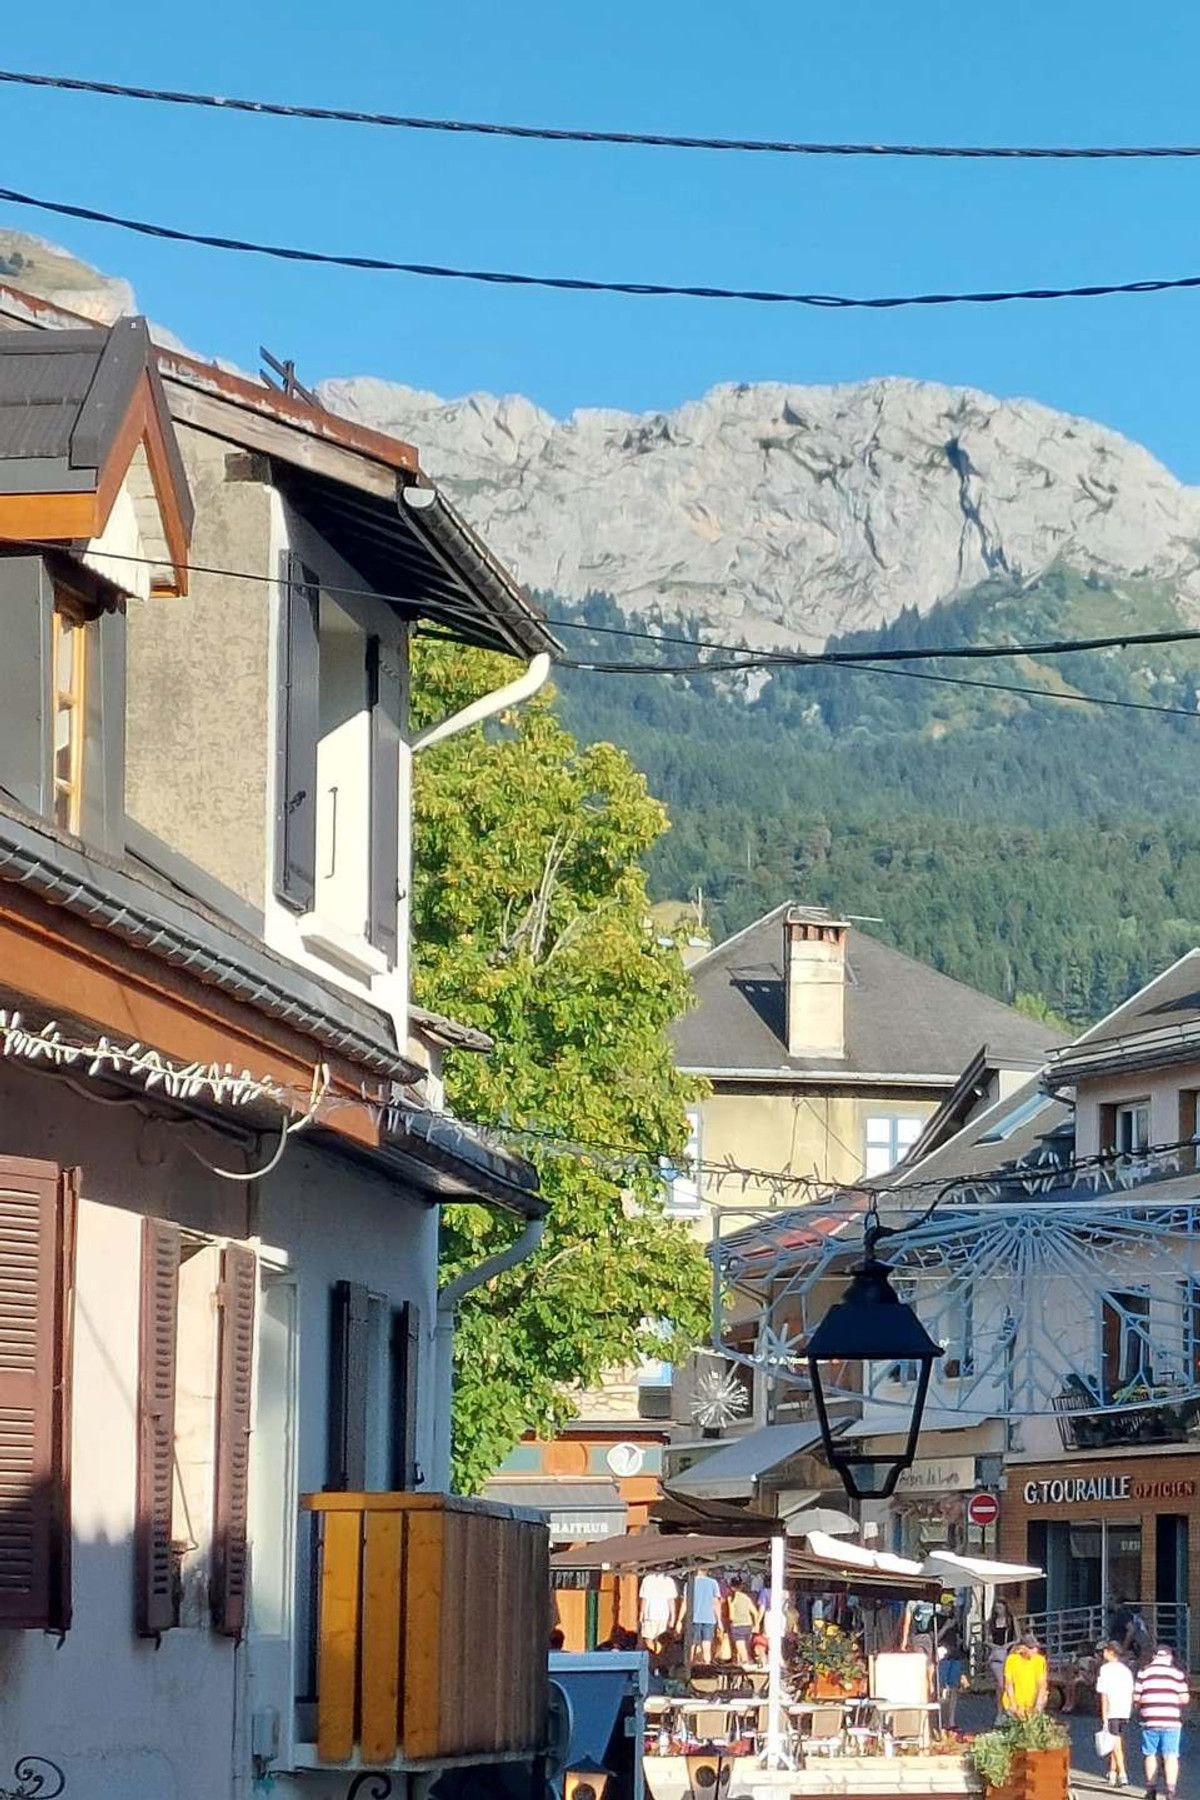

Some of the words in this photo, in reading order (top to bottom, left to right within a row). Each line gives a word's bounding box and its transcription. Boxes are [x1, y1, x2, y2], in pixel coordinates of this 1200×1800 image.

[1024, 1475, 1131, 1504] G.TOURAILLE
[1134, 1480, 1195, 1499] OPTICIEN
[549, 1522, 609, 1534] RAITEUR
